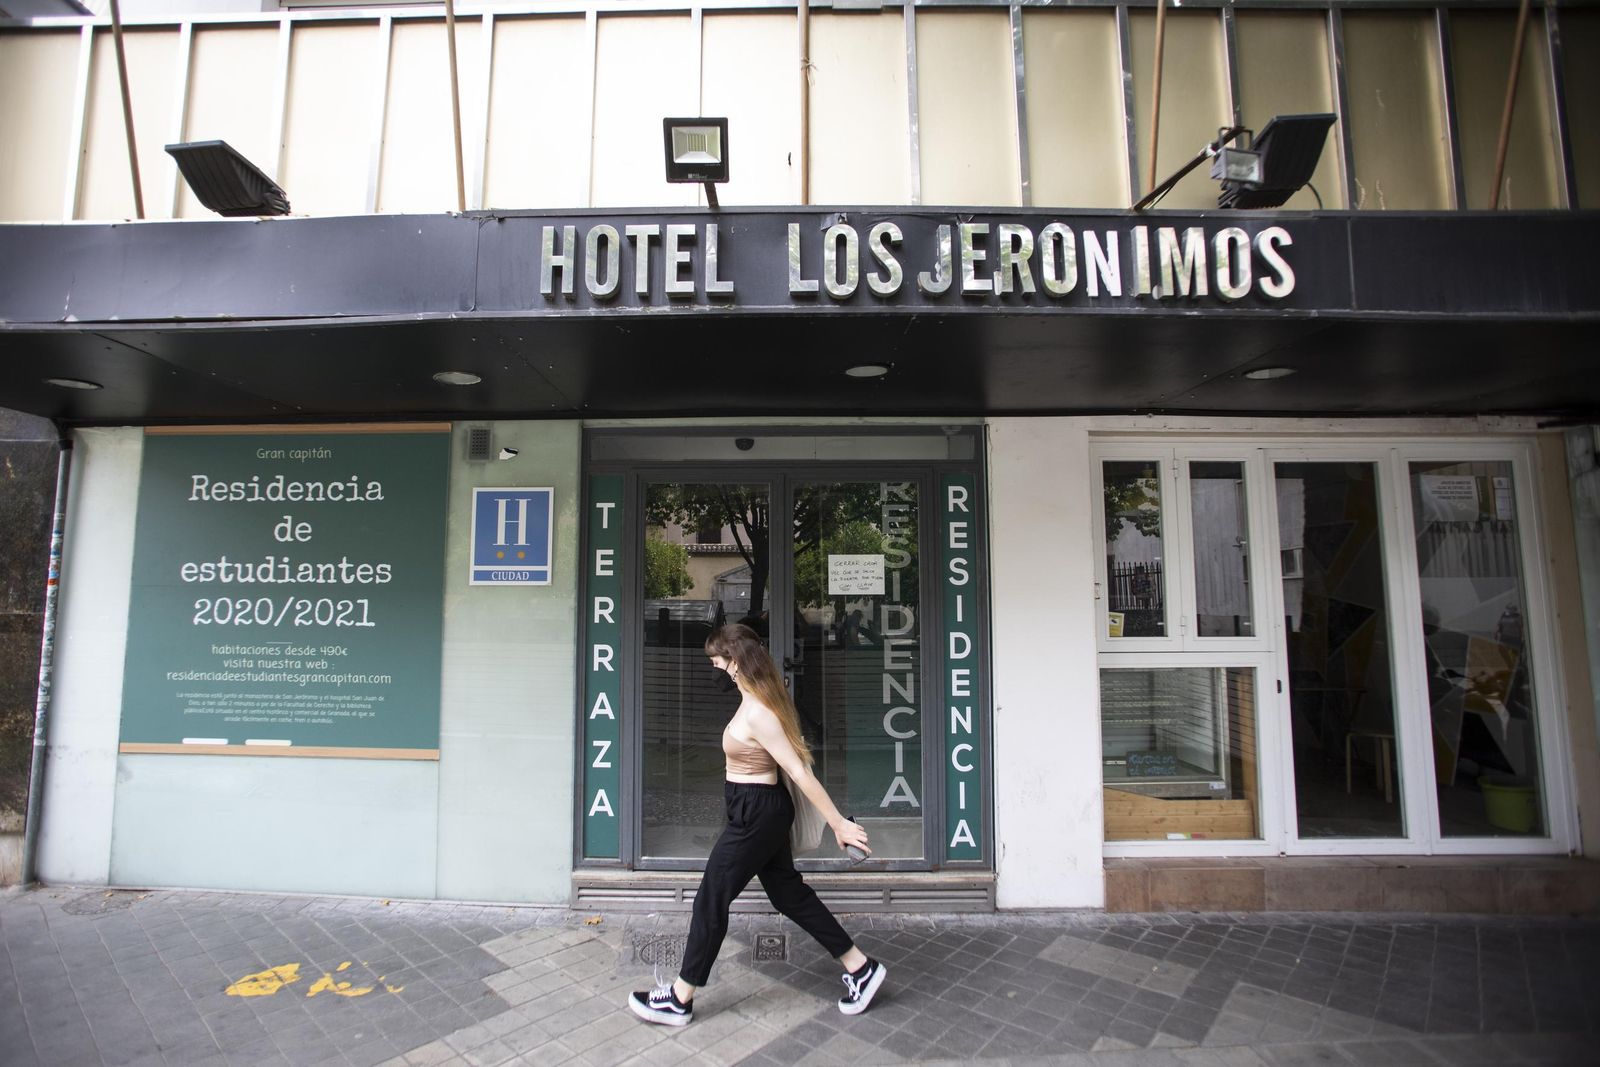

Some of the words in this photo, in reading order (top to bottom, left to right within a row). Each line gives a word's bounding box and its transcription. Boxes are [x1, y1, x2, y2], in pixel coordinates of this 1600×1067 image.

[539, 223, 734, 297] HOTEL
[786, 222, 904, 298] LOS
[918, 221, 1297, 301] JERONIMOS
[256, 448, 285, 459] Gran
[289, 447, 332, 462] capitán
[188, 475, 384, 503] Residencia
[274, 516, 313, 542] de
[492, 499, 533, 546] H
[181, 556, 392, 585] estudiantes
[492, 571, 529, 581] CIUDAD
[193, 597, 376, 627] 2020/2021
[211, 644, 281, 656] habitaciones
[284, 644, 316, 656] desde
[320, 645, 348, 657] 490€
[223, 657, 254, 668] visita
[257, 658, 302, 669] nuestra
[306, 658, 328, 669] web
[589, 502, 616, 817] TERRAZA
[167, 670, 392, 686] residenciadeestudiantesgrancapitan.com
[948, 486, 976, 848] RESIDENCIA
